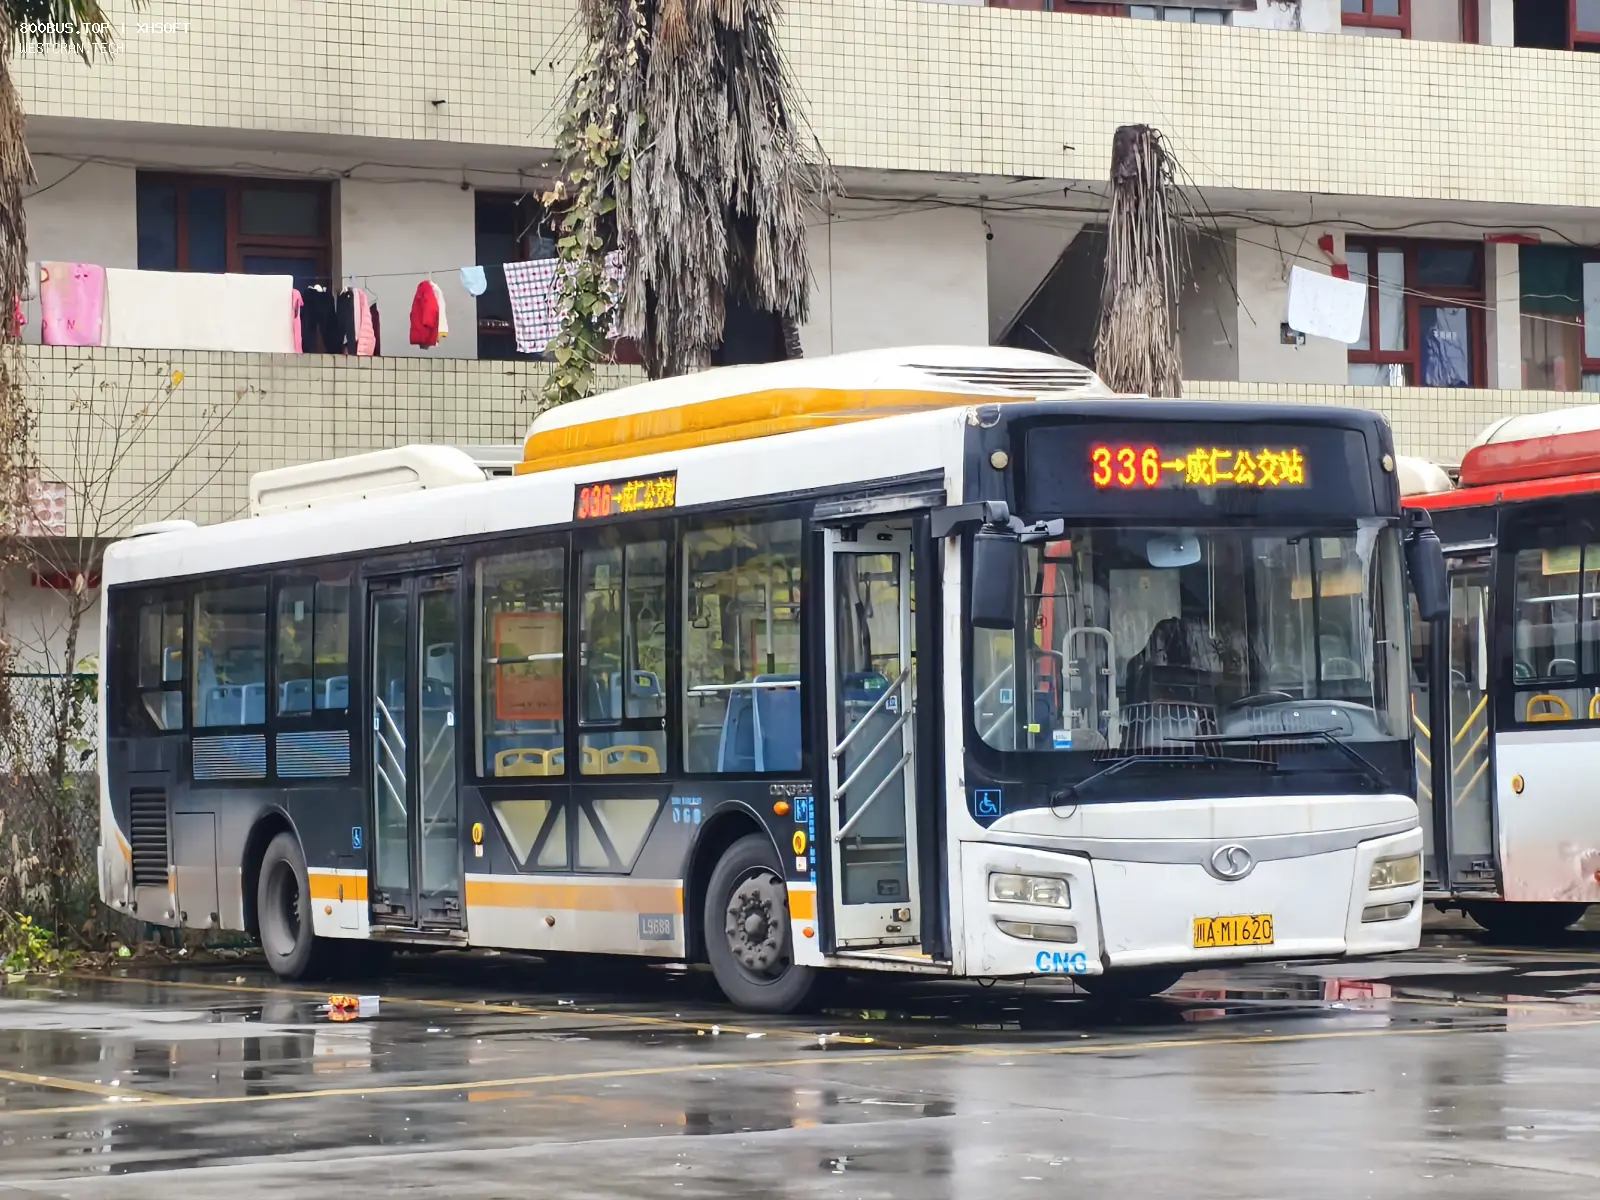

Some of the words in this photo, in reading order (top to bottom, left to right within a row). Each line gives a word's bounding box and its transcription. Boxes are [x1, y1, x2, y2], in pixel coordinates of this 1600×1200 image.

[1092, 446, 1159, 486] 336
[578, 483, 612, 519] 336
[642, 919, 670, 935] L9688
[1035, 951, 1087, 973] CNG
